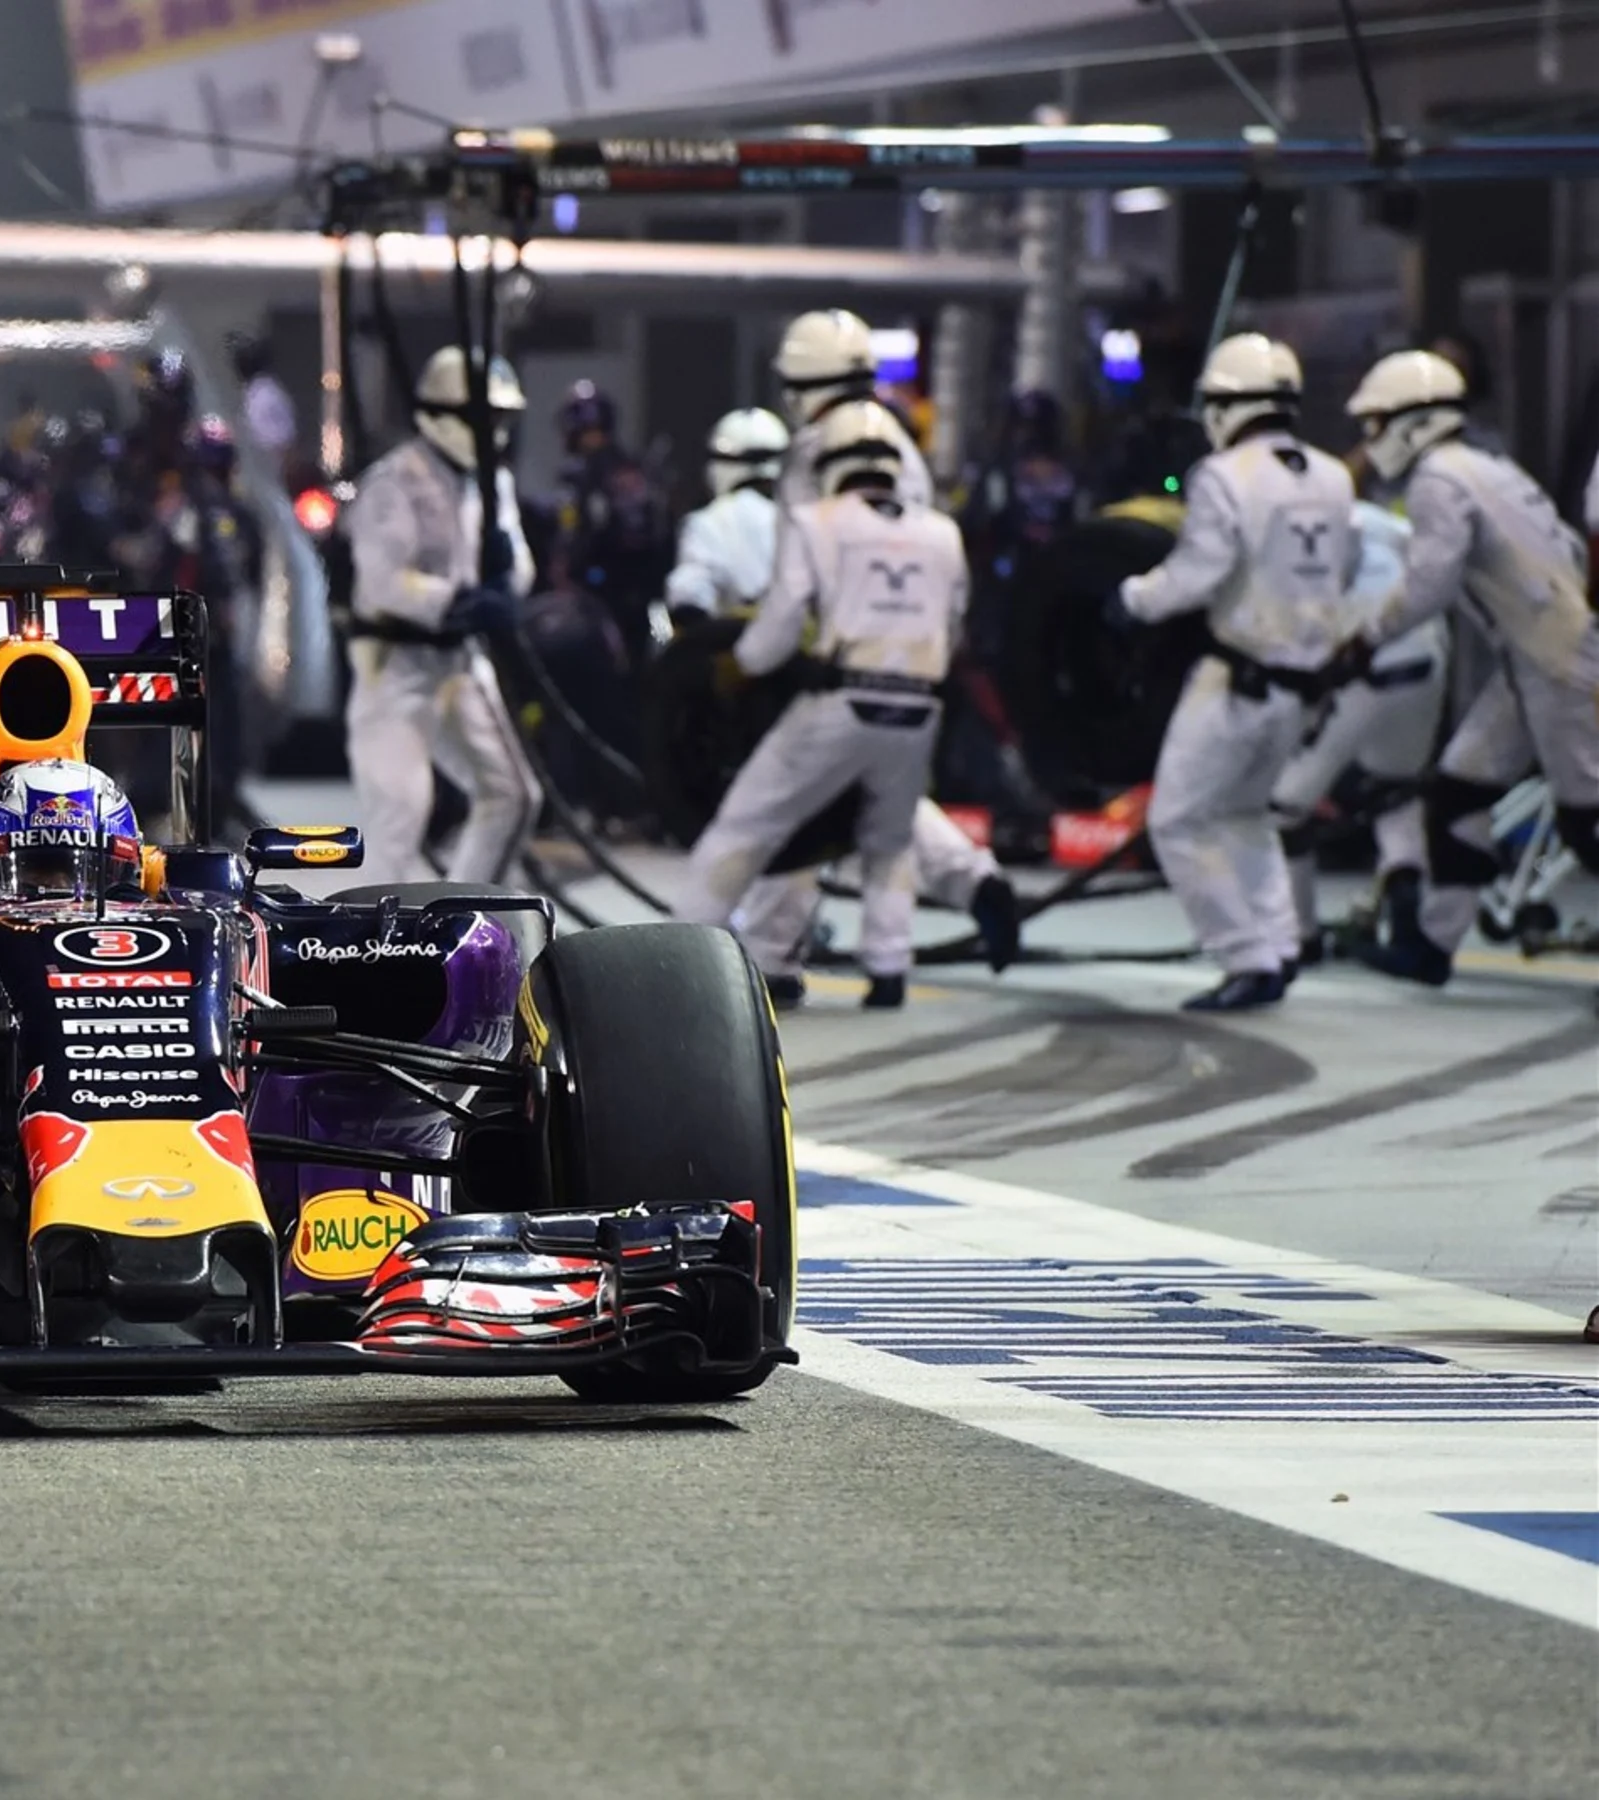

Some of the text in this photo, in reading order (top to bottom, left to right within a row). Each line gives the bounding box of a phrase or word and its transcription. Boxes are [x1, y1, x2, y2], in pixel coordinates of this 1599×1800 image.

[30, 812, 62, 827] Red
[10, 829, 113, 848] RENAULT
[311, 848, 341, 858] RAUCH
[88, 931, 140, 957] 3
[298, 937, 441, 965] Pepe Jeans
[49, 972, 193, 988] TOTAL
[54, 995, 191, 1010] RENAULT
[61, 1017, 191, 1034] PIRELLI
[64, 1043, 196, 1059] CASIO
[68, 1068, 200, 1082] Hisense
[71, 1089, 203, 1108] Pepe Jeans
[314, 1215, 407, 1253] RAUCH
